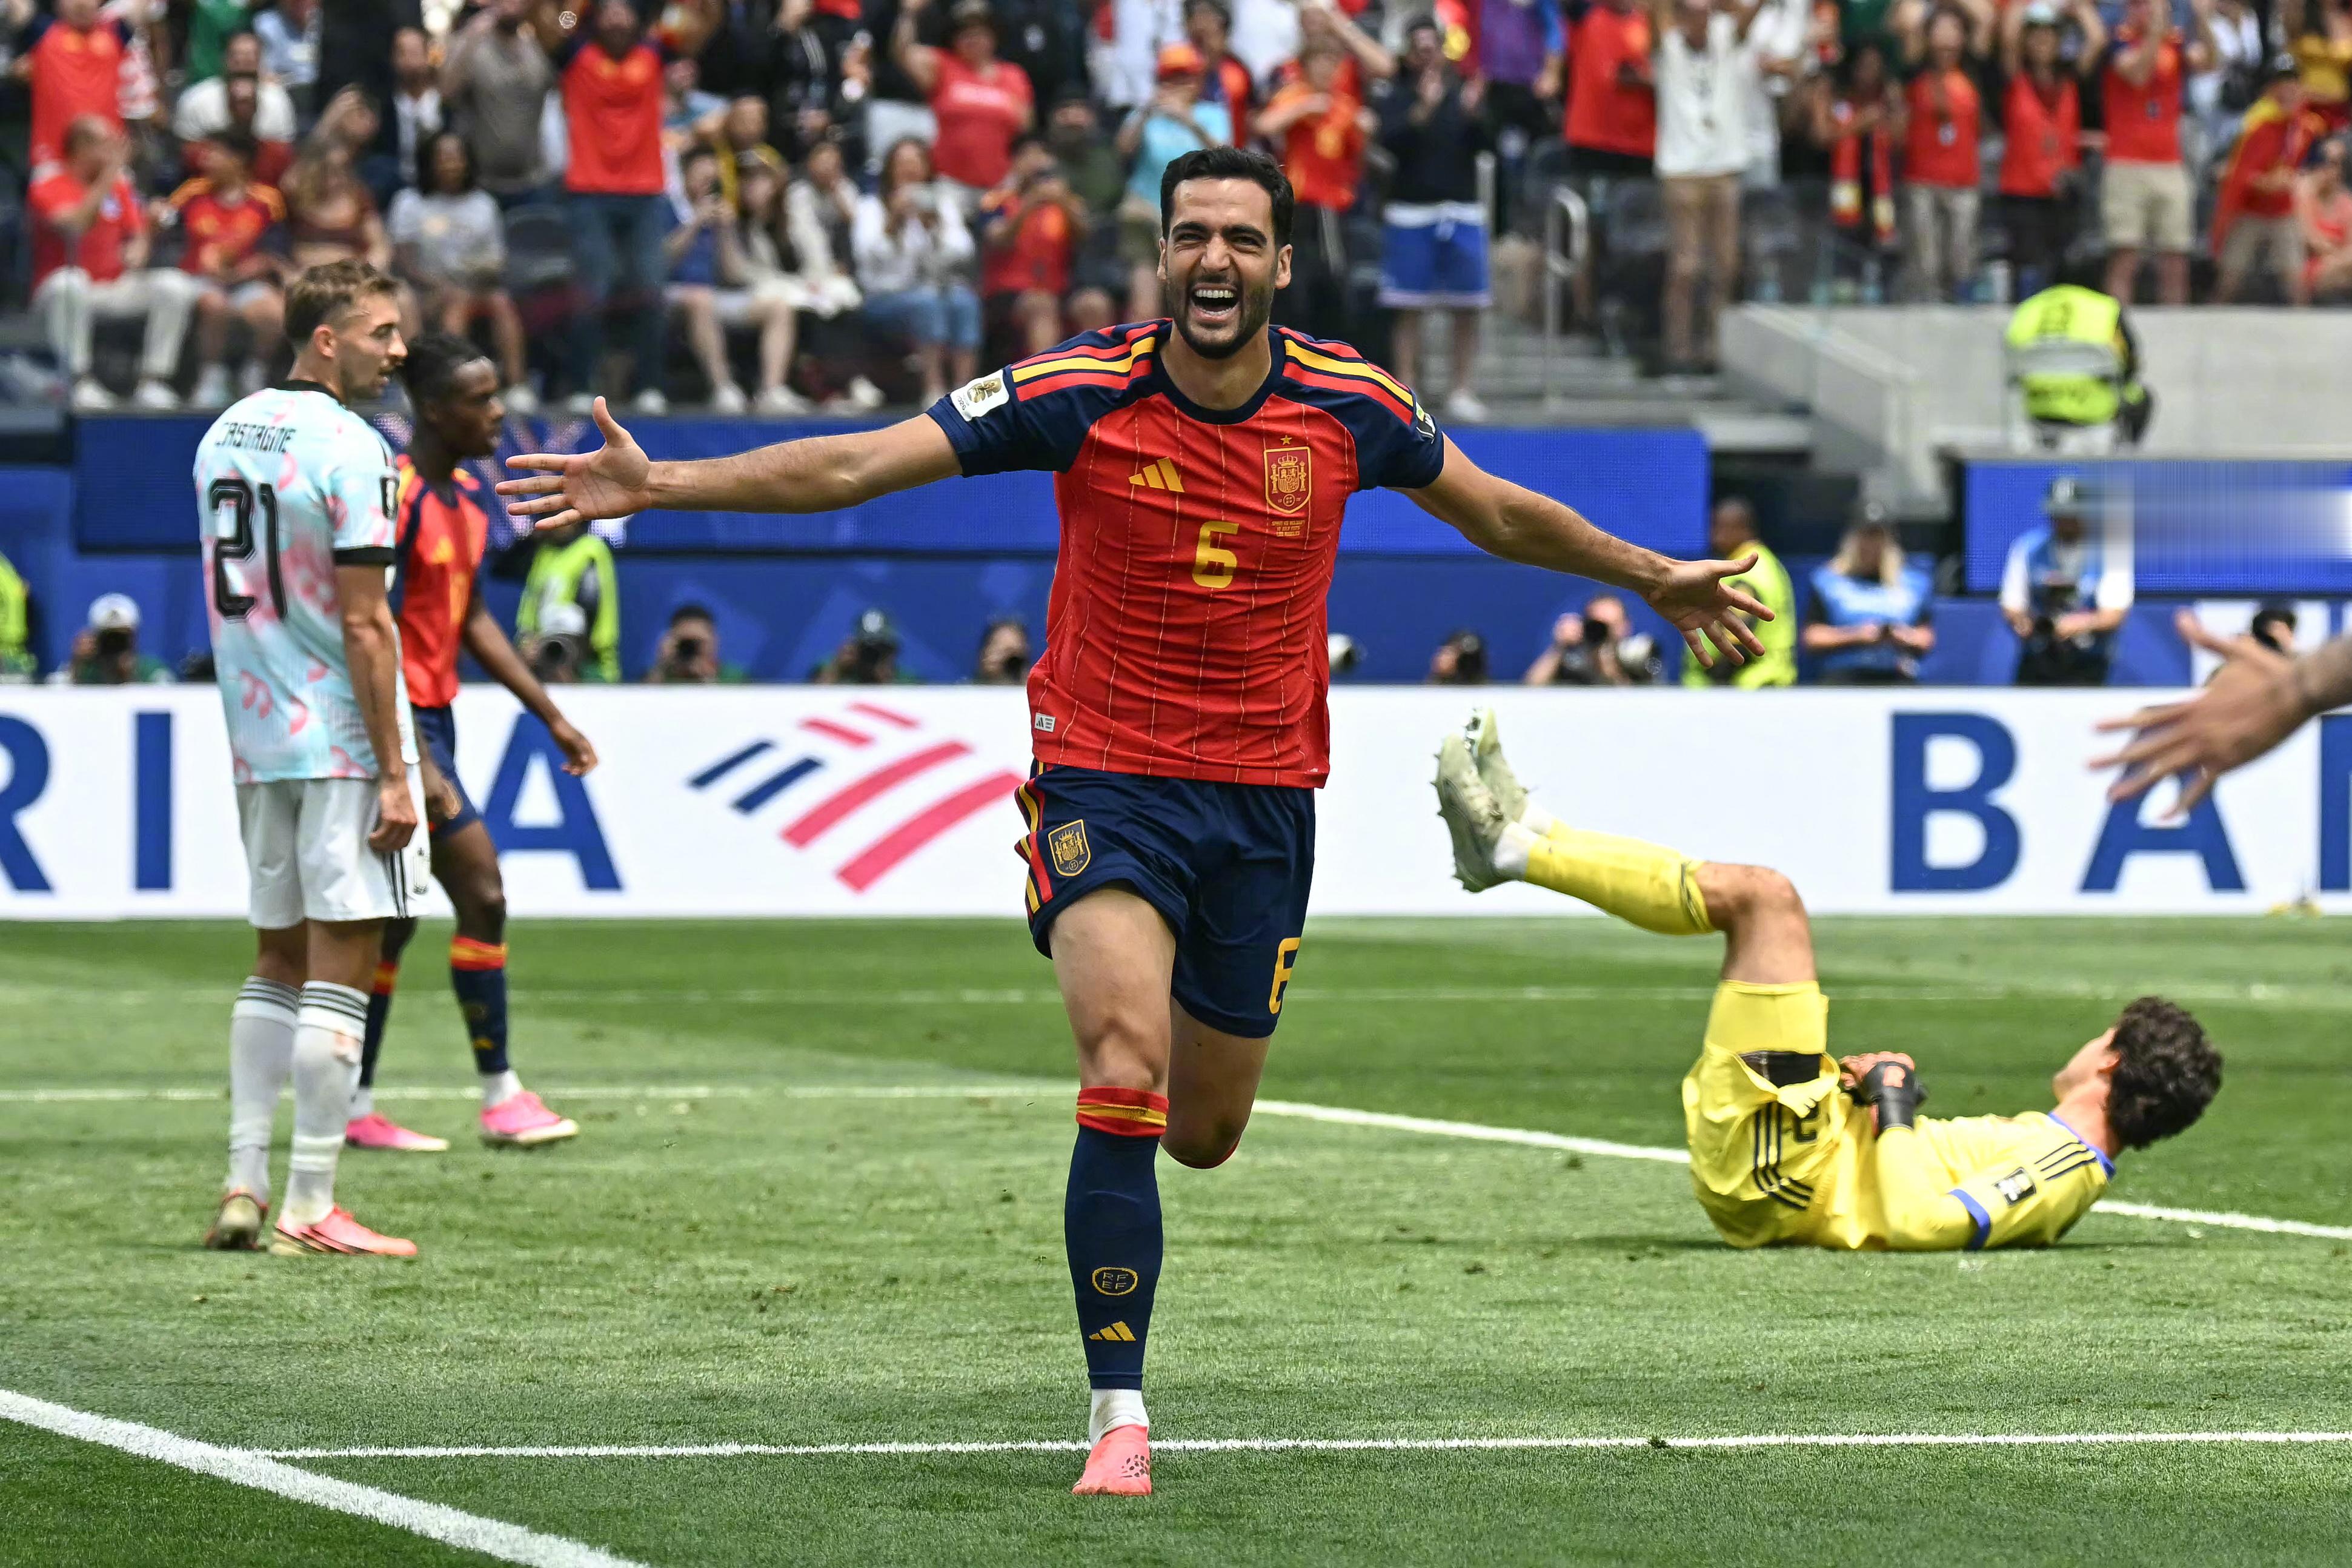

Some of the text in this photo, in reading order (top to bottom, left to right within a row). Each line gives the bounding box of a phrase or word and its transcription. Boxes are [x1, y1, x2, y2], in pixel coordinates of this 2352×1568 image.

[209, 477, 287, 622] 21
[1192, 520, 1240, 589] 6
[0, 712, 622, 892] IA
[1891, 711, 2352, 893] BA
